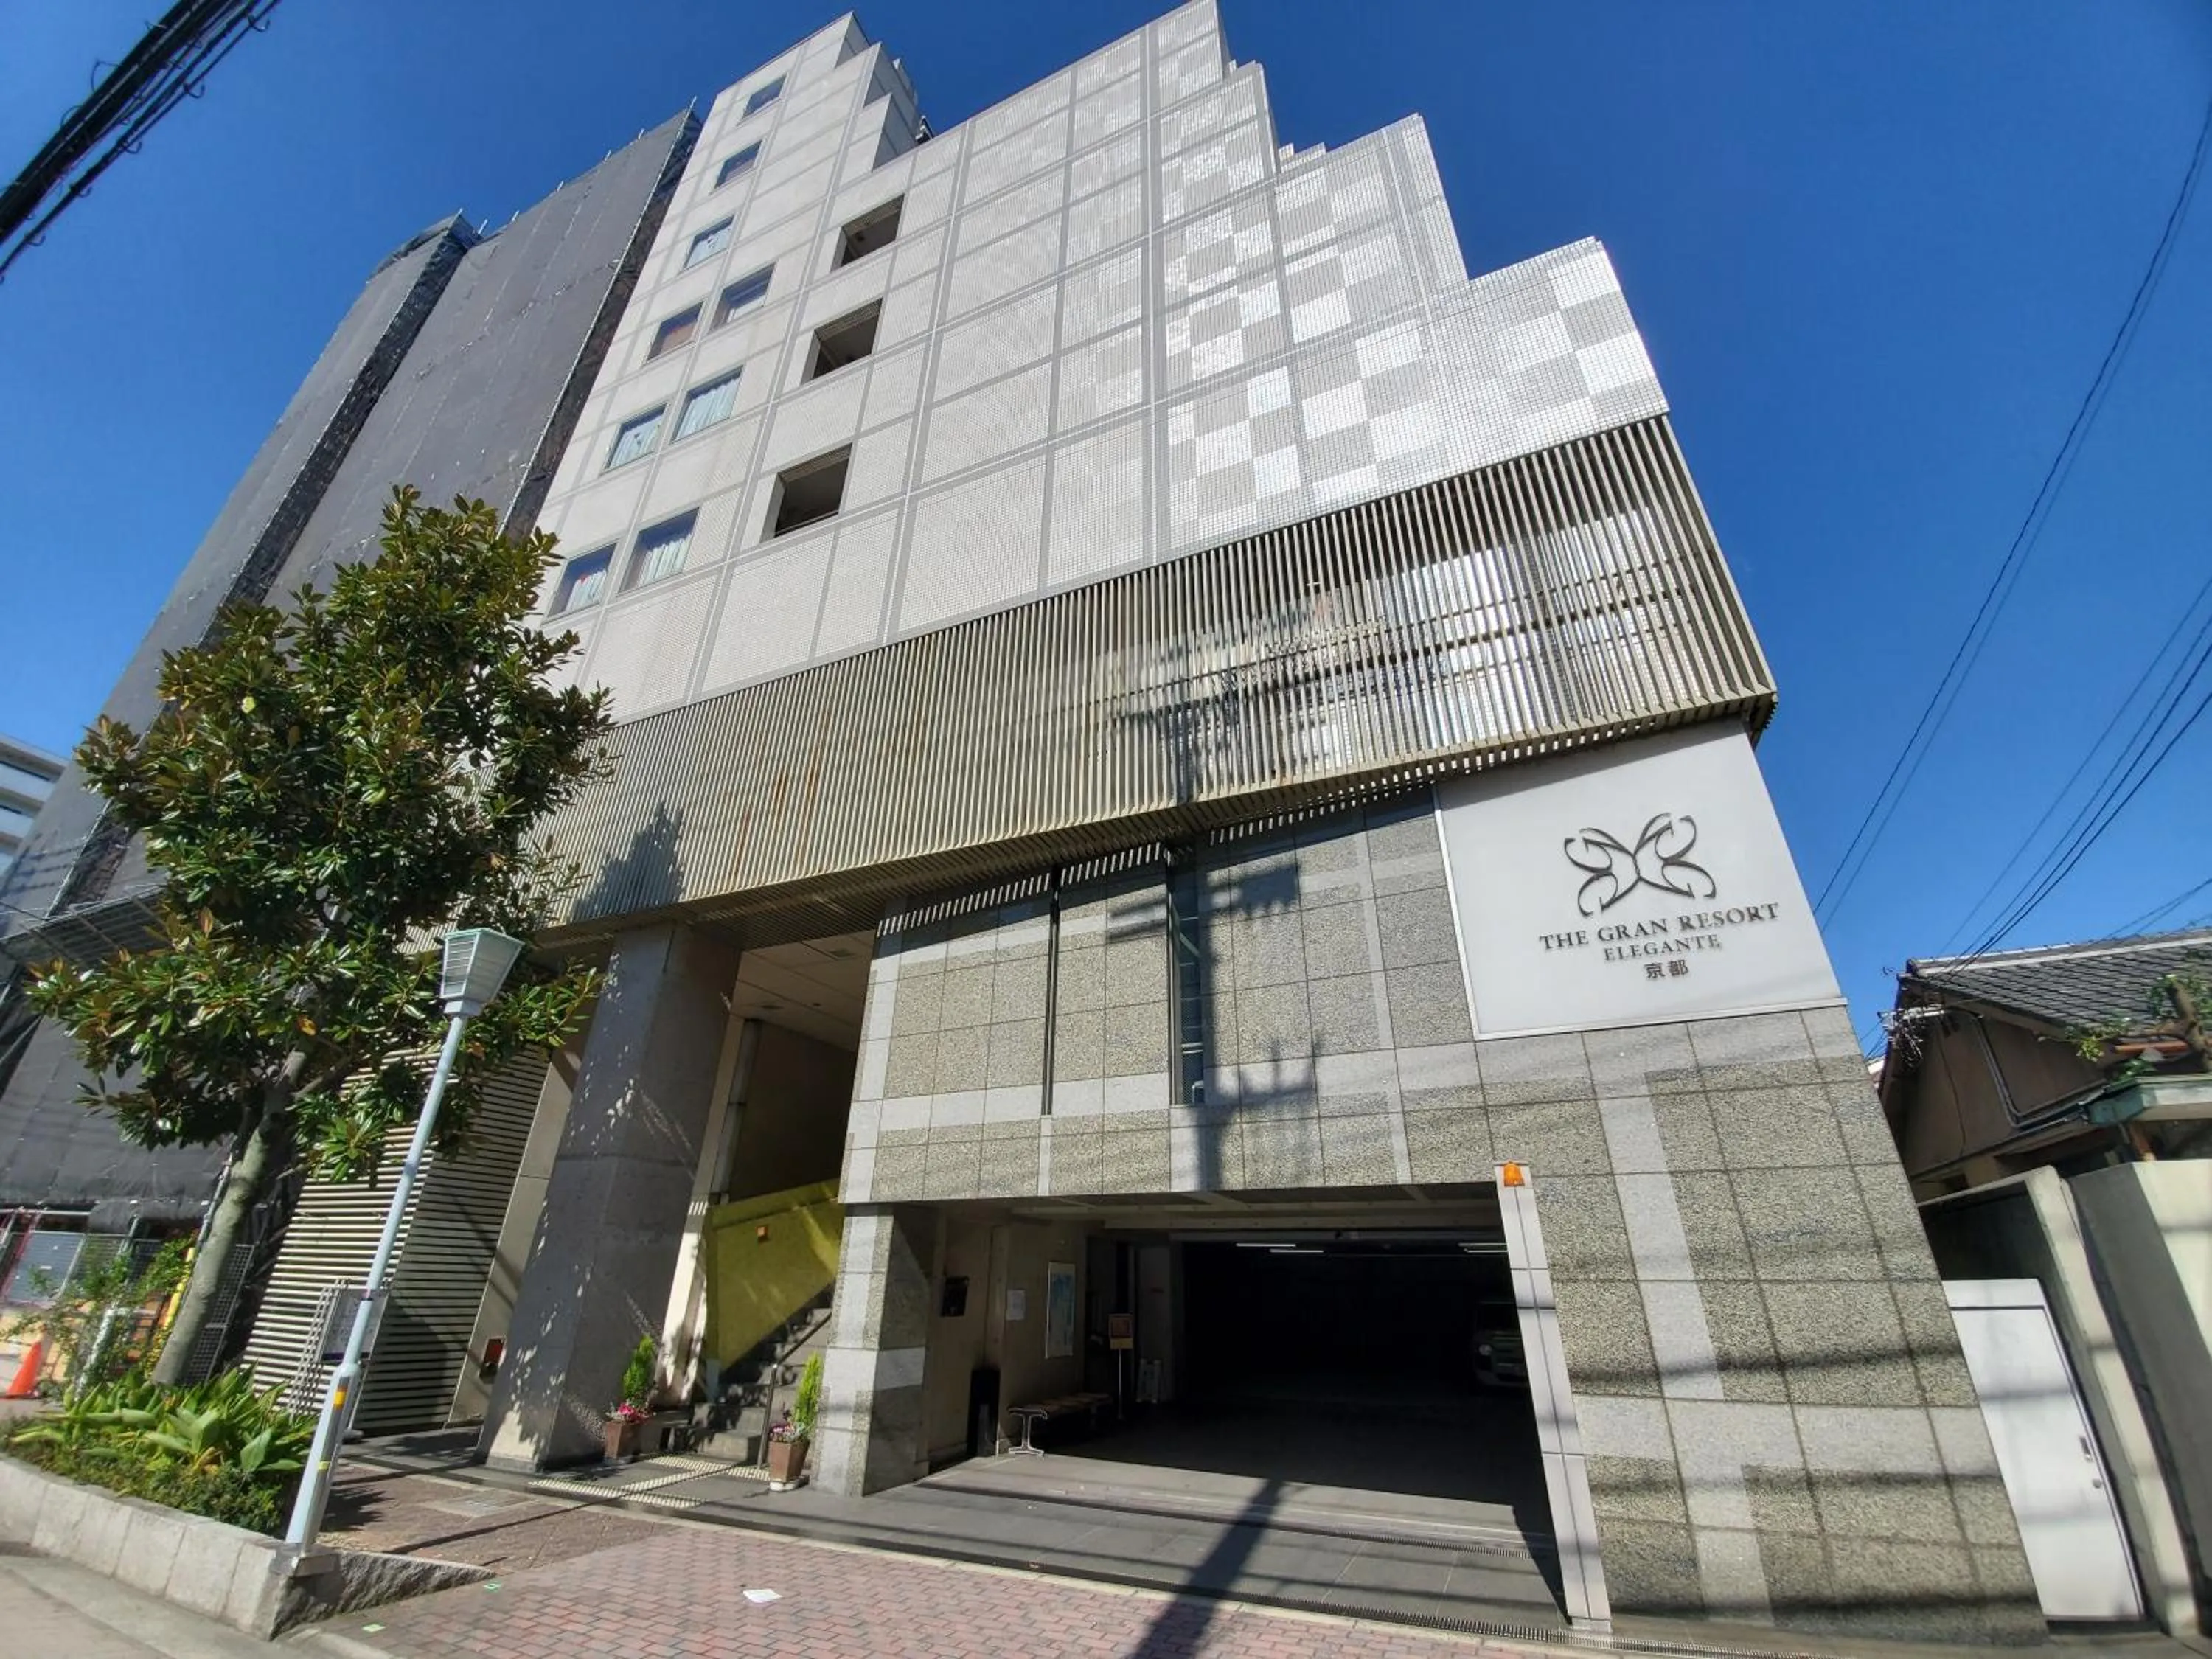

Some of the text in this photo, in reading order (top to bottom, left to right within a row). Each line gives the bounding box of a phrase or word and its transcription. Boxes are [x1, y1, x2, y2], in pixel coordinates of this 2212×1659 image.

[1539, 903, 1780, 950] THE GRAN RESORT
[1604, 933, 1722, 961] ELEGANTE
[1644, 959, 1689, 979] 京都
